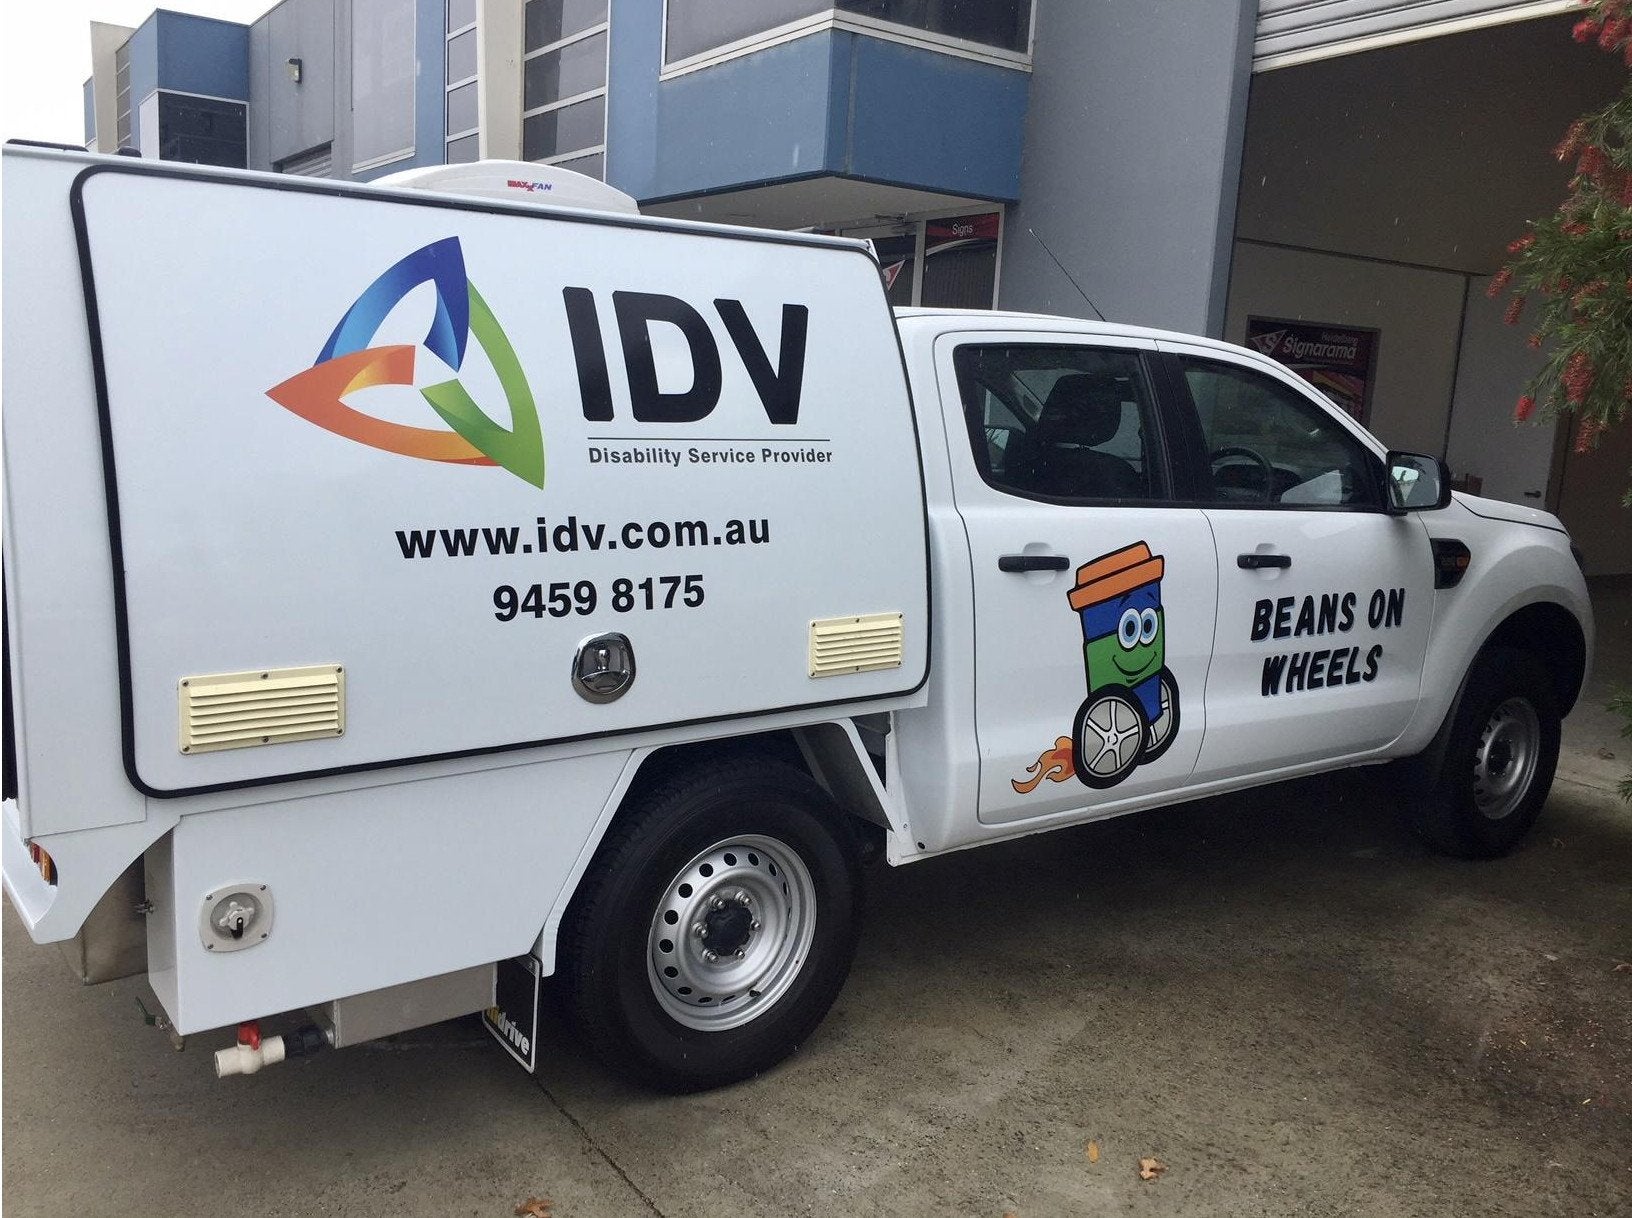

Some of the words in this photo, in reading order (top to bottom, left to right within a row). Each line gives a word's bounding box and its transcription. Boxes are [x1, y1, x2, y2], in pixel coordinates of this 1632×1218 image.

[952, 223, 973, 237] Signs
[562, 286, 809, 425] IDV
[1282, 336, 1357, 359] Signarama
[588, 447, 682, 467] Disability
[688, 447, 756, 464] Service
[761, 448, 833, 464] Provider
[395, 515, 770, 559] www.idv.com.au
[493, 580, 598, 622] 9459
[611, 574, 705, 613] 8175
[1250, 591, 1356, 642] BEANS
[1367, 587, 1405, 629] ON
[1260, 644, 1383, 696] WHEELS
